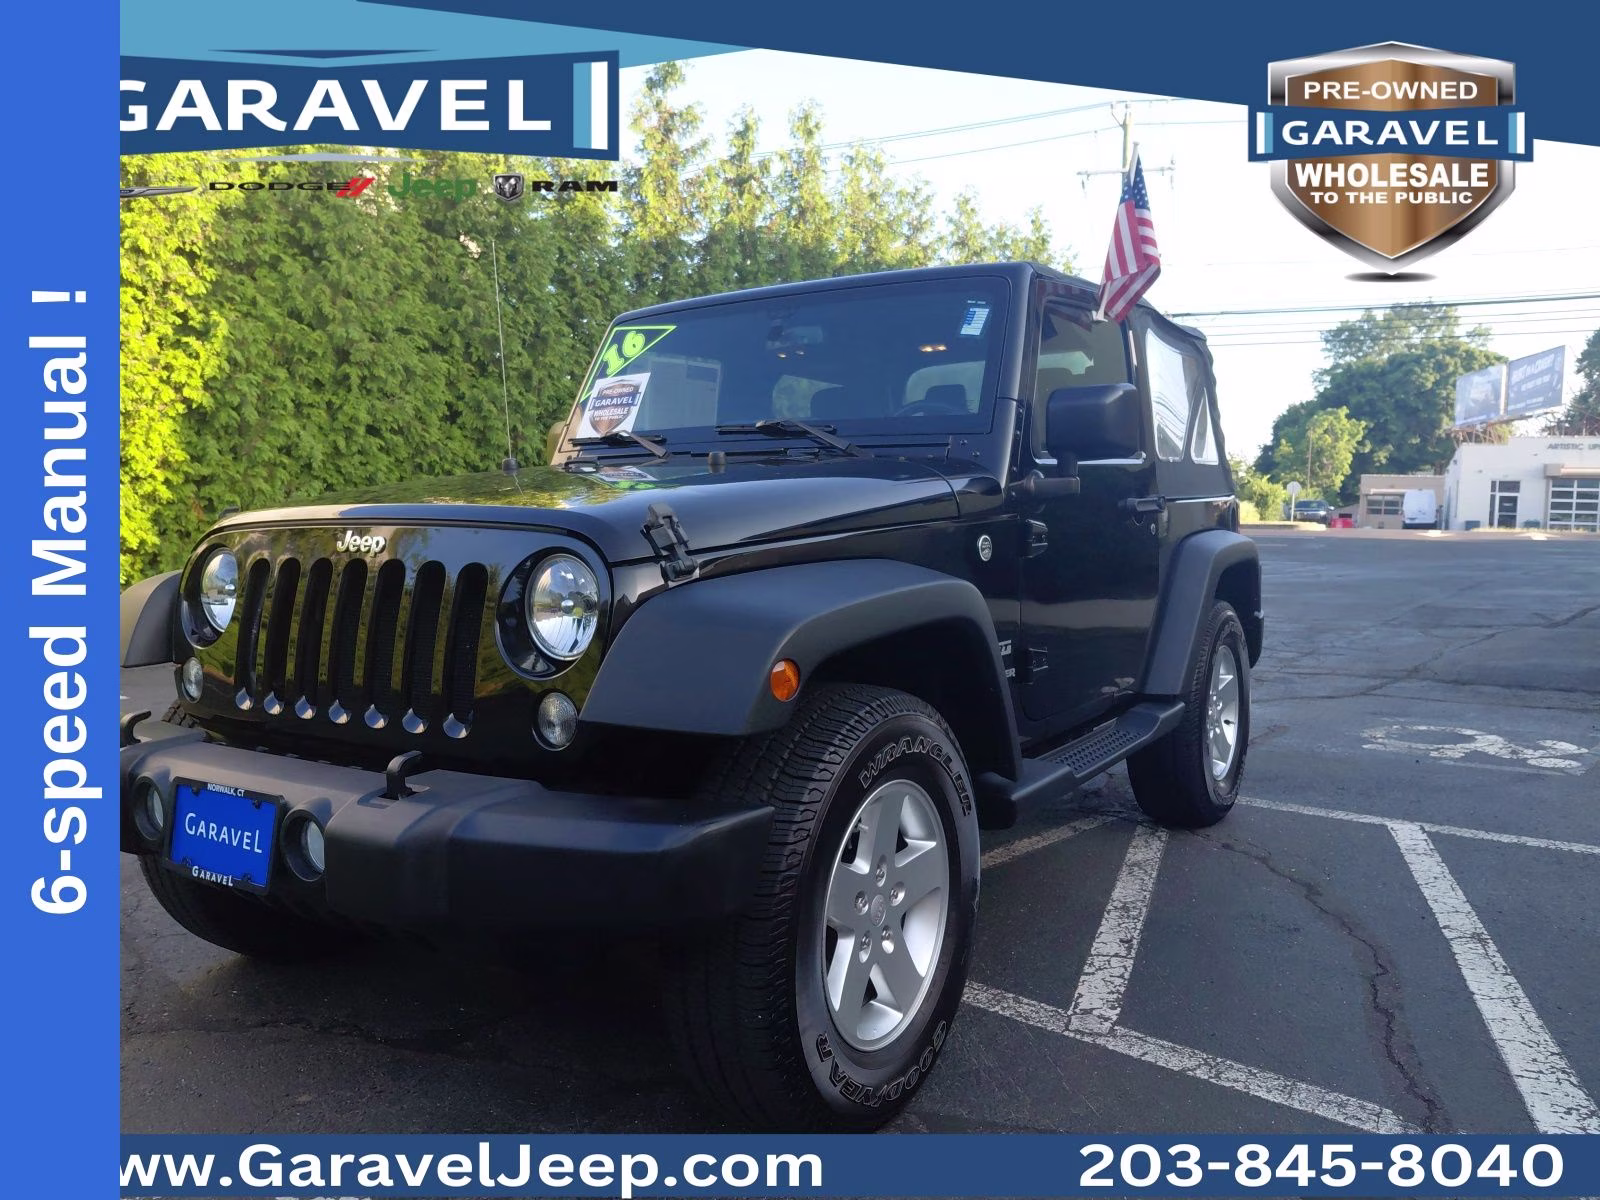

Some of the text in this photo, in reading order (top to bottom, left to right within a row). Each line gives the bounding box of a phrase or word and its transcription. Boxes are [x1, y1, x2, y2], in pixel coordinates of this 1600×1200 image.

[603, 331, 645, 375] 16
[594, 407, 628, 417] WHOLESALE
[595, 396, 633, 406] GARAVEL
[336, 530, 386, 558] Jeep
[859, 736, 972, 817] WRANGLER
[237, 788, 245, 798] CT
[815, 1020, 947, 1108] GOODYEAR
